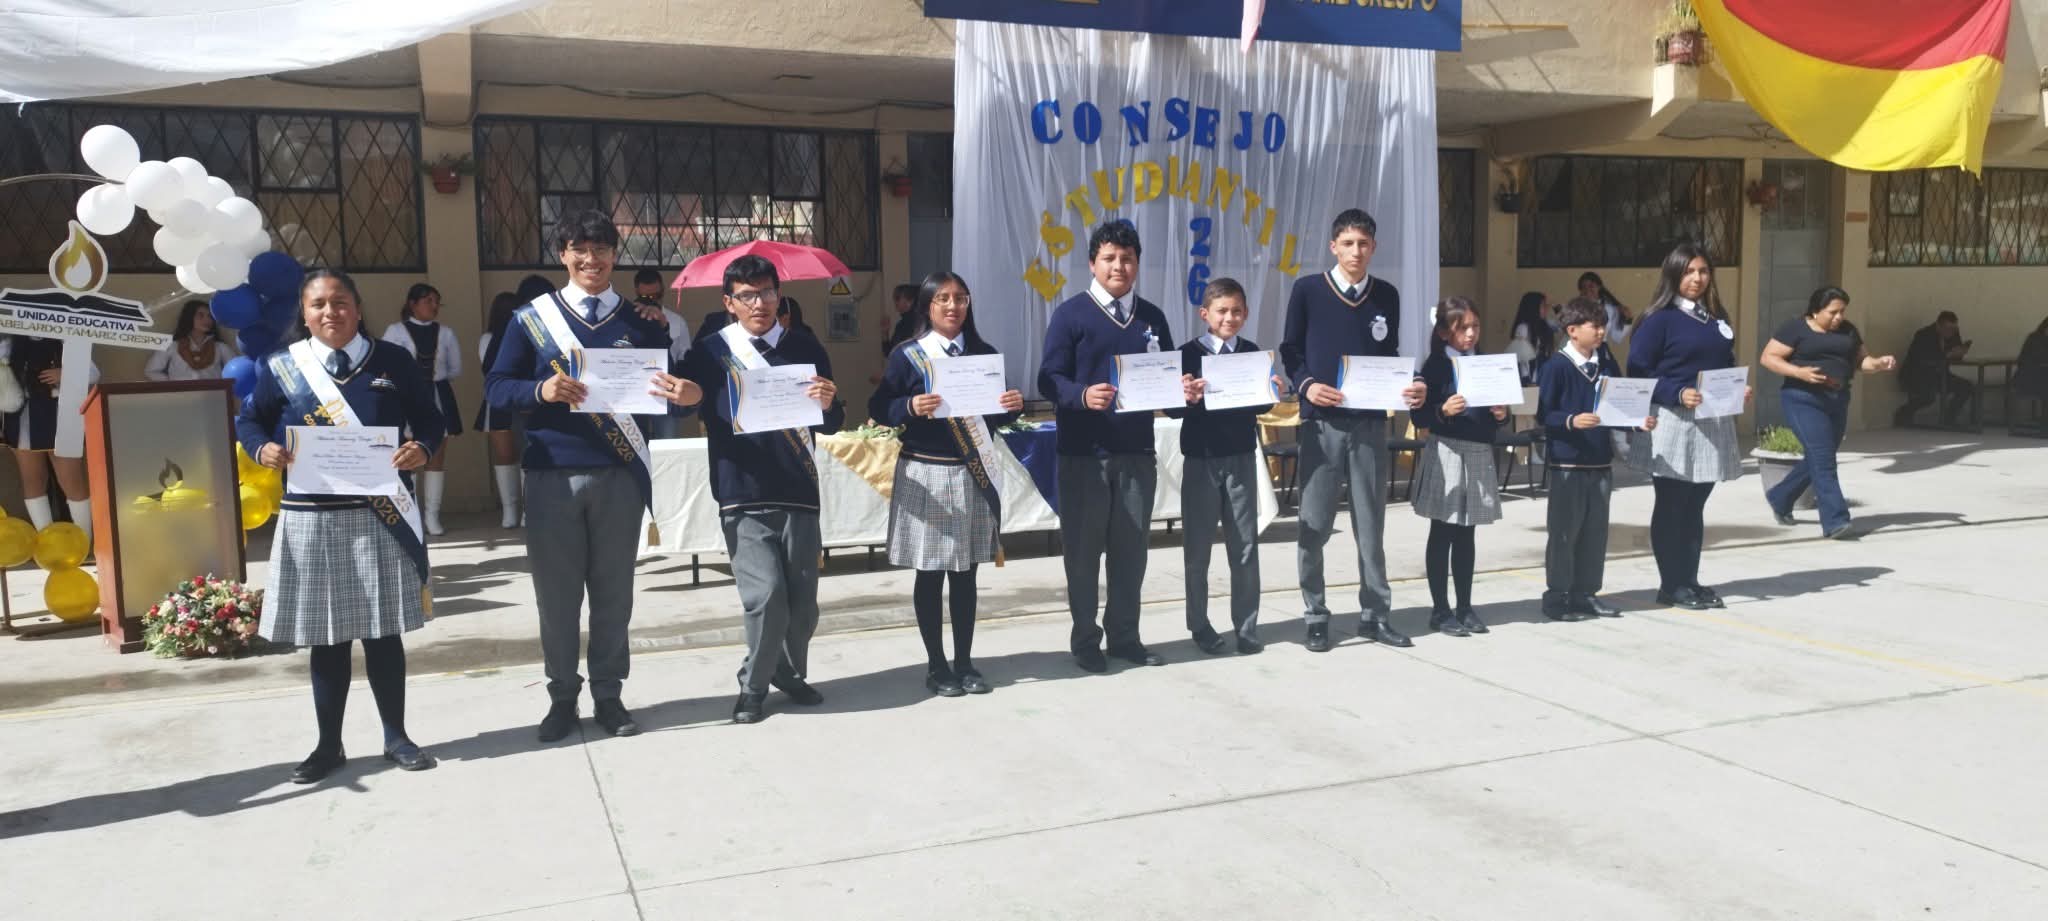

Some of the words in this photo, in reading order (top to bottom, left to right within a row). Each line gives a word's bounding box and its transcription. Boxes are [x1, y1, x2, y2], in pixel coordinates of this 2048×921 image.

[1031, 97, 1286, 153] CONSEJO
[1024, 155, 1301, 302] ESTUDIANTIL
[17, 309, 65, 323] UNIDAD
[68, 315, 136, 331] EDUCATIVA
[66, 326, 117, 340] TAMARIZ
